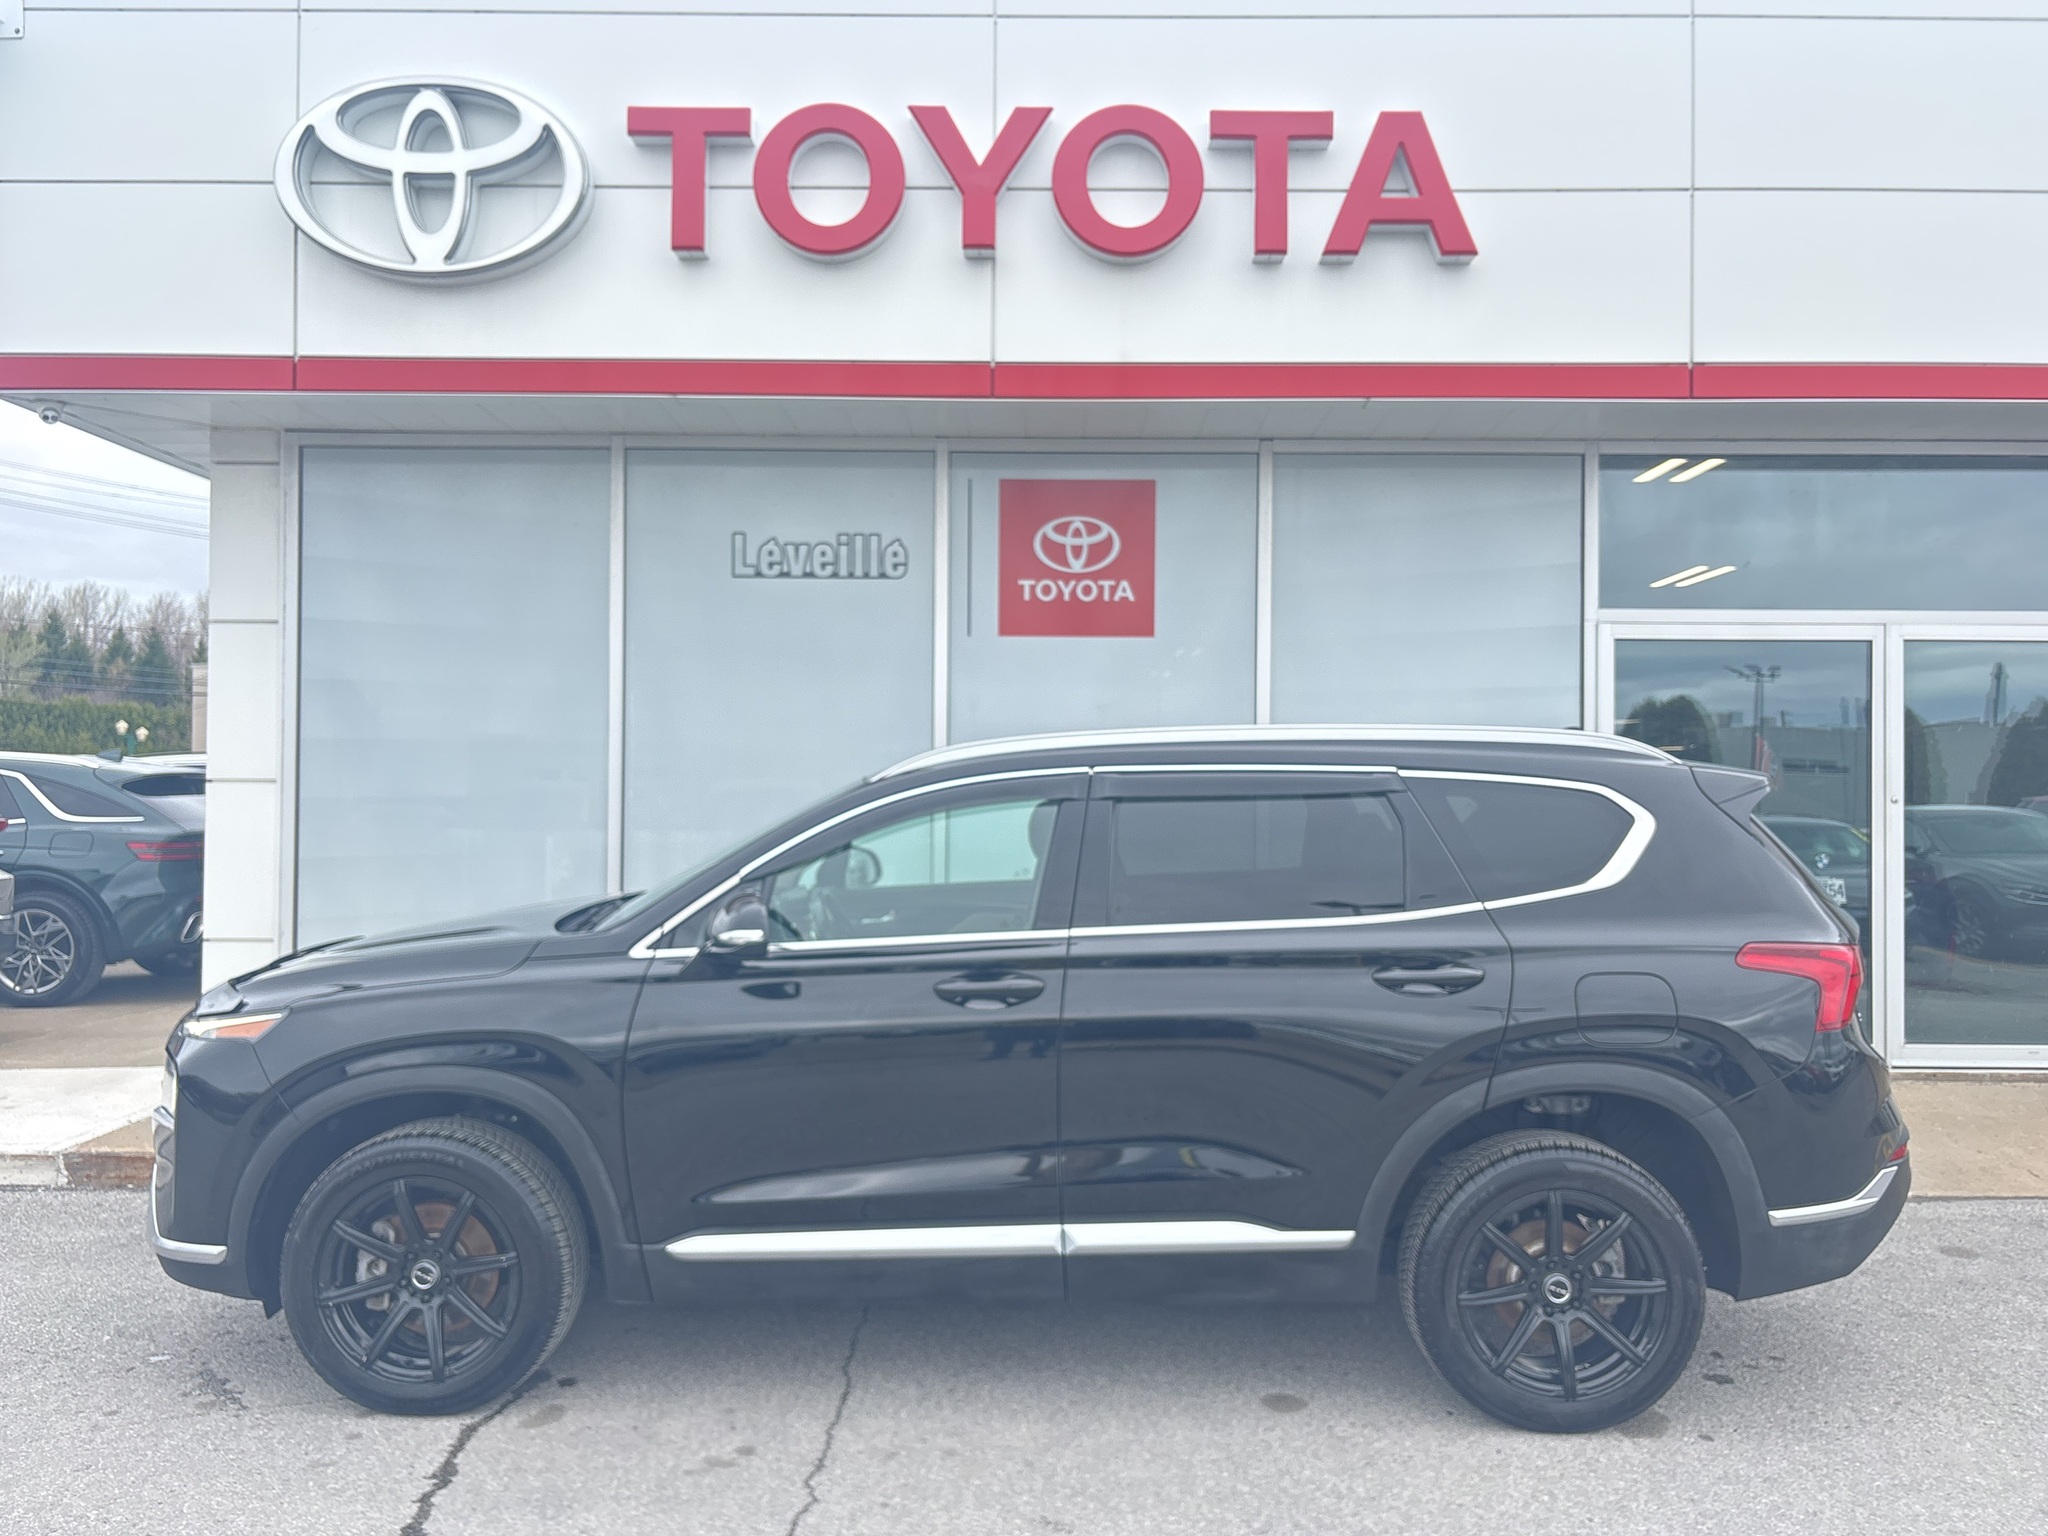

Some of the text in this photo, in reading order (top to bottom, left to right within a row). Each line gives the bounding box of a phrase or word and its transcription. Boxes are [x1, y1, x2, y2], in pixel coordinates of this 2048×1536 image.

[627, 103, 1478, 262] TOYOTA
[731, 531, 909, 580] Léveillé
[1017, 579, 1136, 602] TOYOTA
